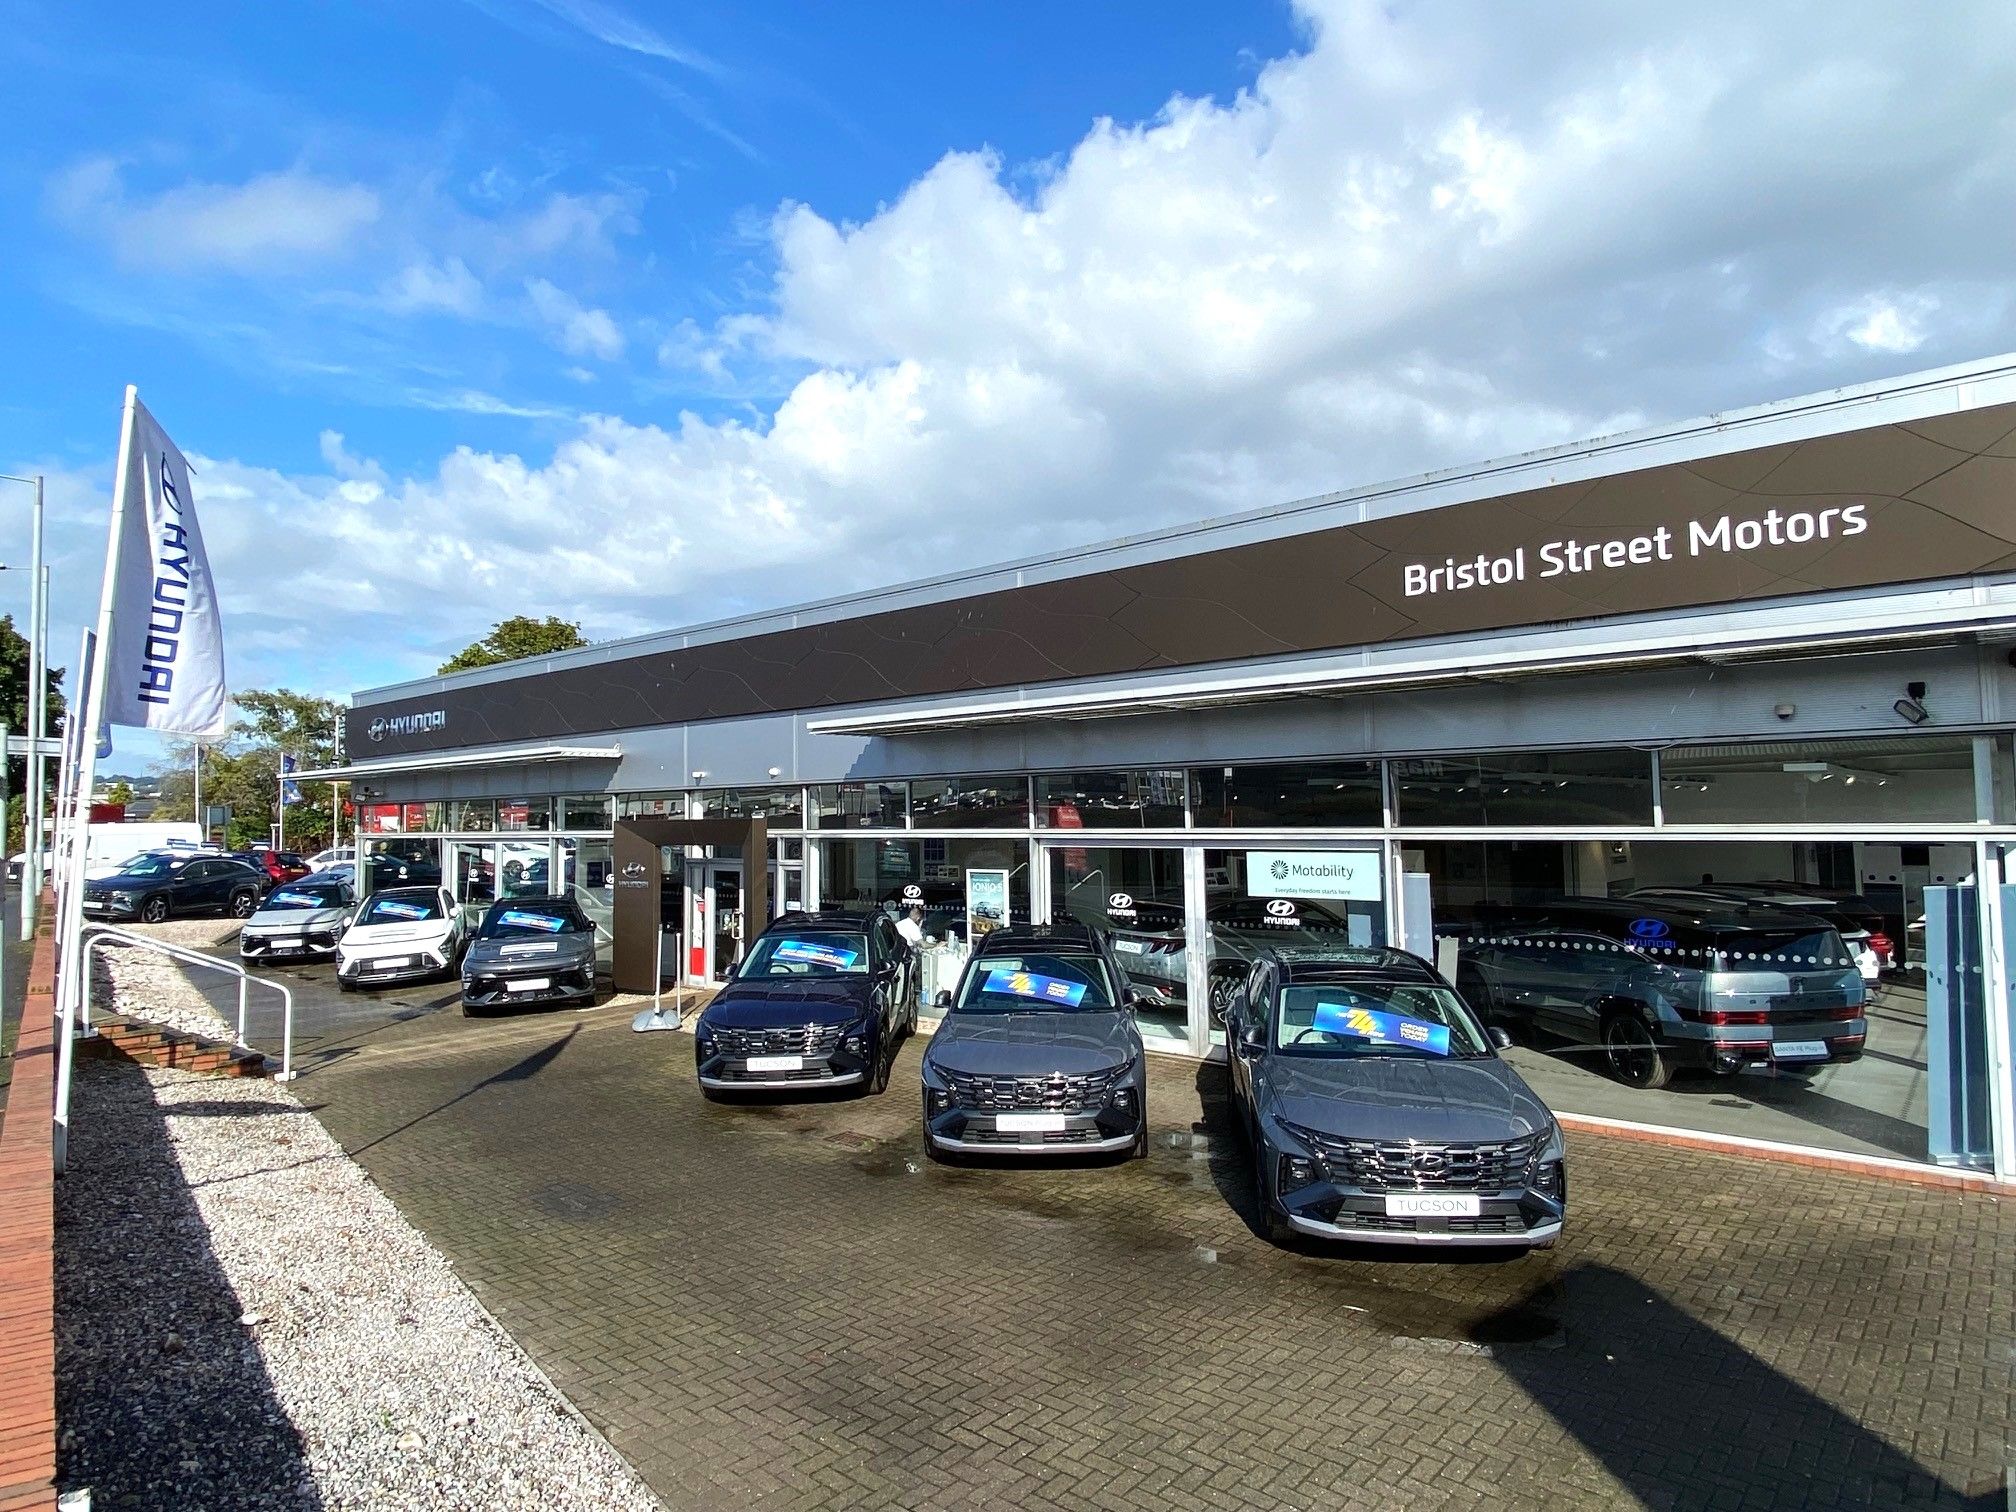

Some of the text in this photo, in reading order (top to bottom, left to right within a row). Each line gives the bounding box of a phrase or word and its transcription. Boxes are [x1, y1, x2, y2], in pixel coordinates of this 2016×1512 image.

[1404, 504, 1868, 598] Bristol Street Motors
[138, 522, 190, 704] HYUNDAI
[389, 710, 446, 736] HYUNDAI
[1292, 864, 1354, 880] Motability
[1263, 916, 1300, 926] HYUNDAI
[1623, 938, 1676, 949] HYUNDAI
[1398, 1199, 1469, 1212] TUCSON
